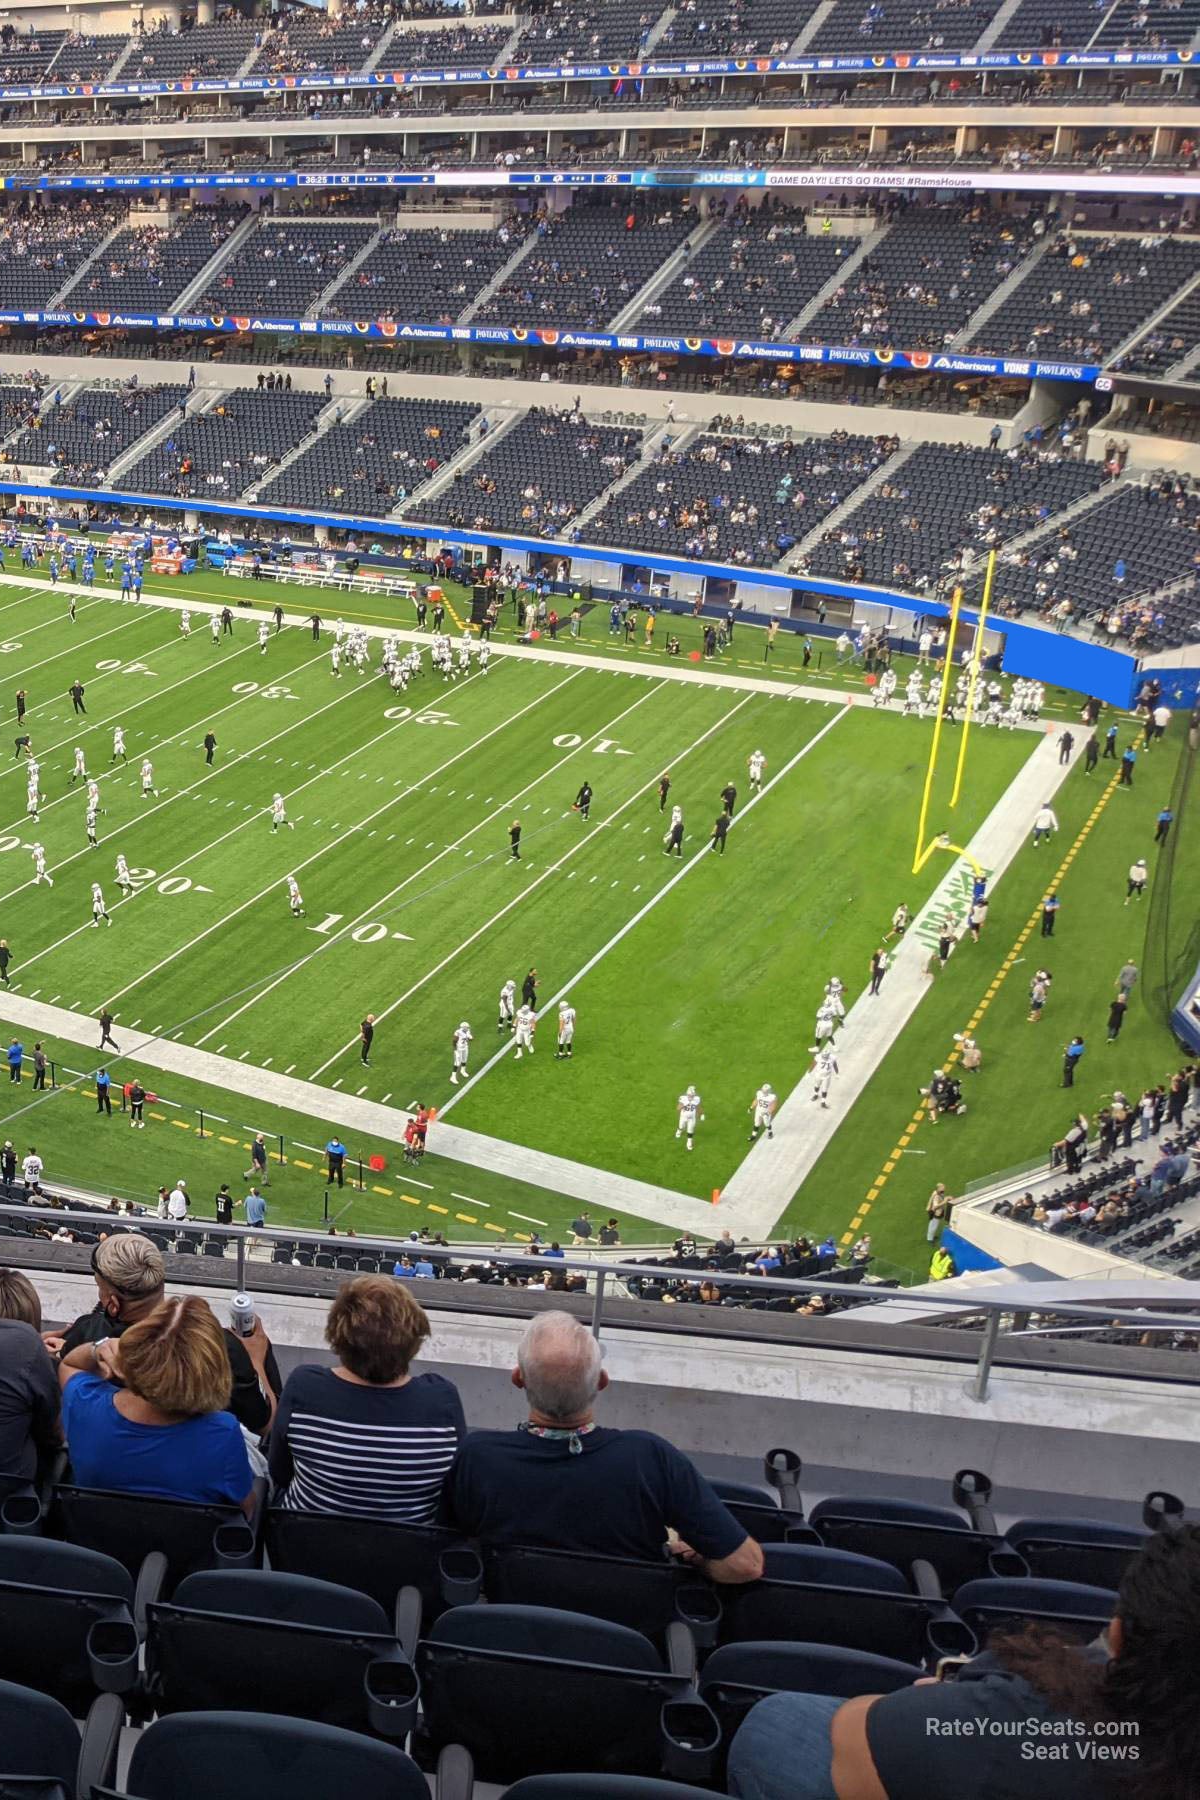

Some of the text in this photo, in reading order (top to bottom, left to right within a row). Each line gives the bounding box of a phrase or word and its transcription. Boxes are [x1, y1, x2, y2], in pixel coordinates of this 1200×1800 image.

[305, 176, 327, 184] 36:25
[770, 176, 798, 185] GAME
[828, 176, 853, 185] LETS
[855, 176, 870, 185] GO
[873, 176, 905, 186] RAMS!
[907, 177, 972, 186] #RamsHouse
[752, 347, 869, 363] Albertsons VONS PAVILIONS
[950, 360, 1081, 378] Albertsons VONS PAVILIONS
[1097, 378, 1111, 389] CC
[306, 912, 388, 943] 10
